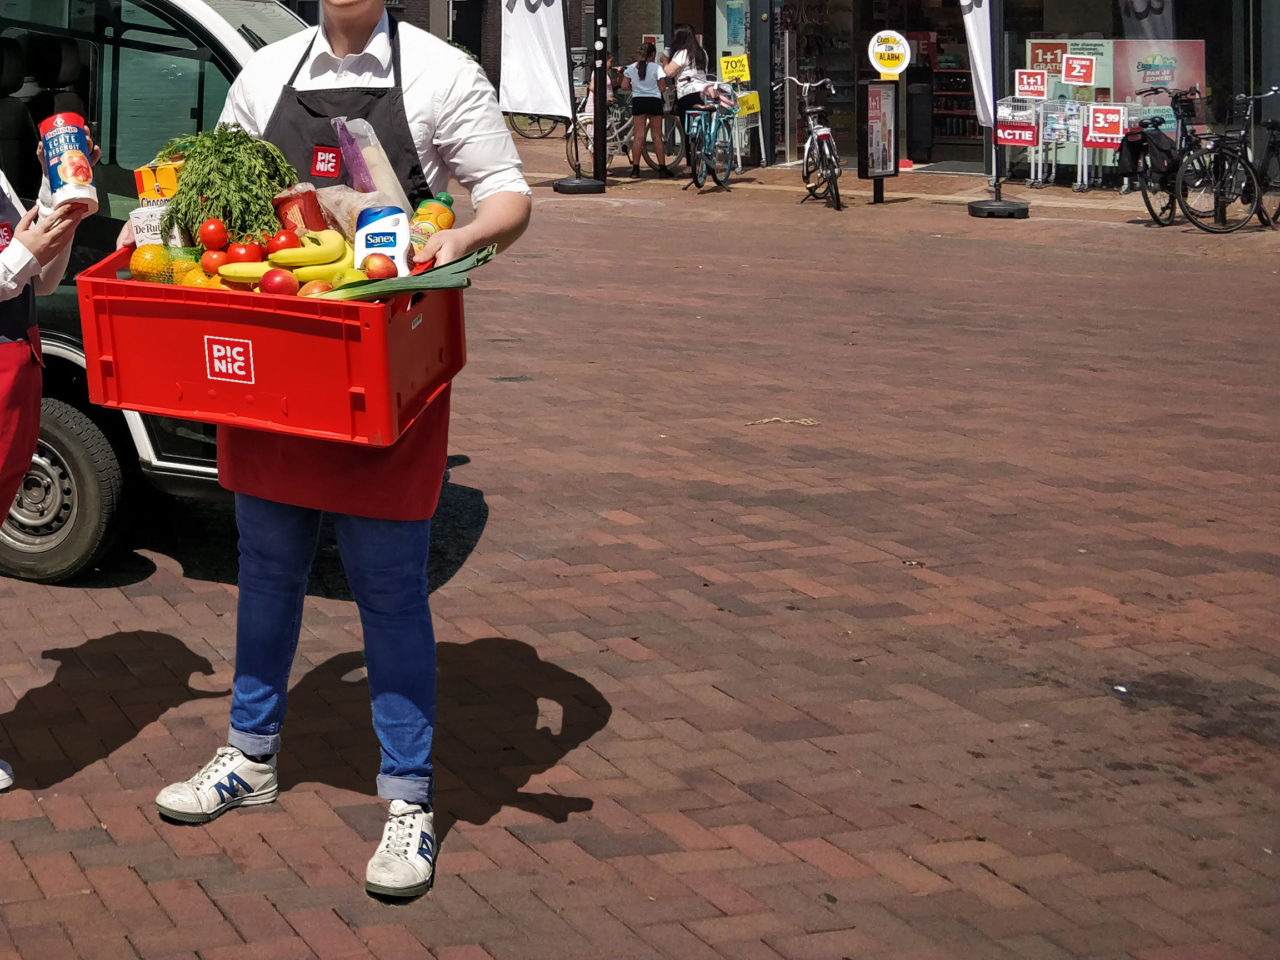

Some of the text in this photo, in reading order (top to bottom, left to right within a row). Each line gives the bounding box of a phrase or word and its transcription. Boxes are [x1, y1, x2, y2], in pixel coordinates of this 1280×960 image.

[879, 53, 900, 62] ALARM
[1035, 49, 1063, 63] 1+1
[724, 59, 746, 70] 70%
[1021, 75, 1042, 85] 1+1
[1094, 113, 1119, 127] 3.99
[997, 129, 1033, 140] ACTIE
[49, 135, 76, 149] ECHTE
[367, 234, 395, 244] Sanex
[212, 344, 245, 361] PIC
